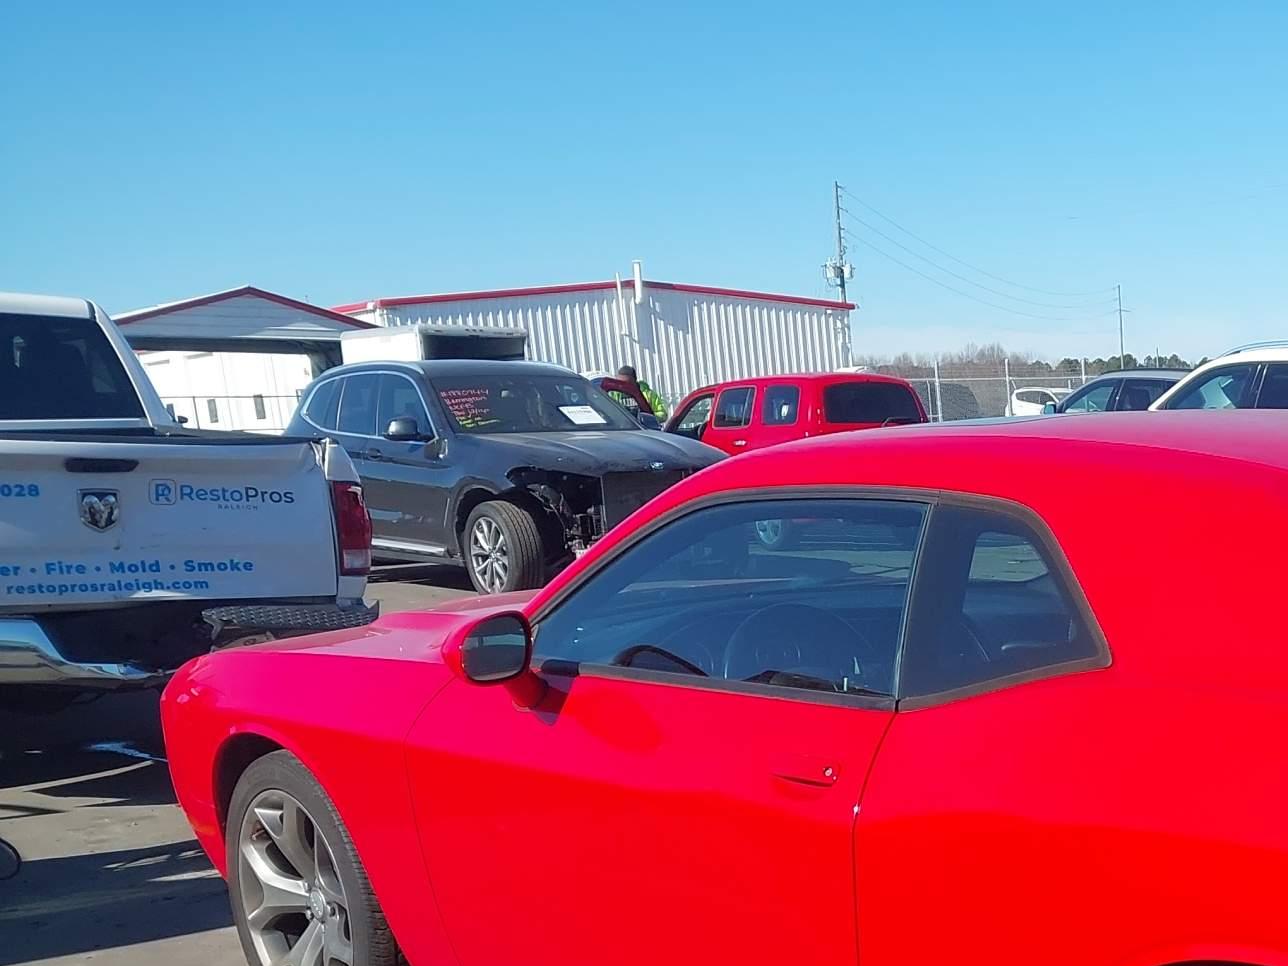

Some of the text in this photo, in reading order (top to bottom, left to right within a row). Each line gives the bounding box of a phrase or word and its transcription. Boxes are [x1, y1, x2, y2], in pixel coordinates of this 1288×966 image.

[179, 484, 295, 504] RestoPros
[45, 561, 87, 576] Fire
[109, 559, 161, 575] Mold
[184, 558, 254, 573] Smoke
[6, 578, 210, 596] restoprosraleigh.com
